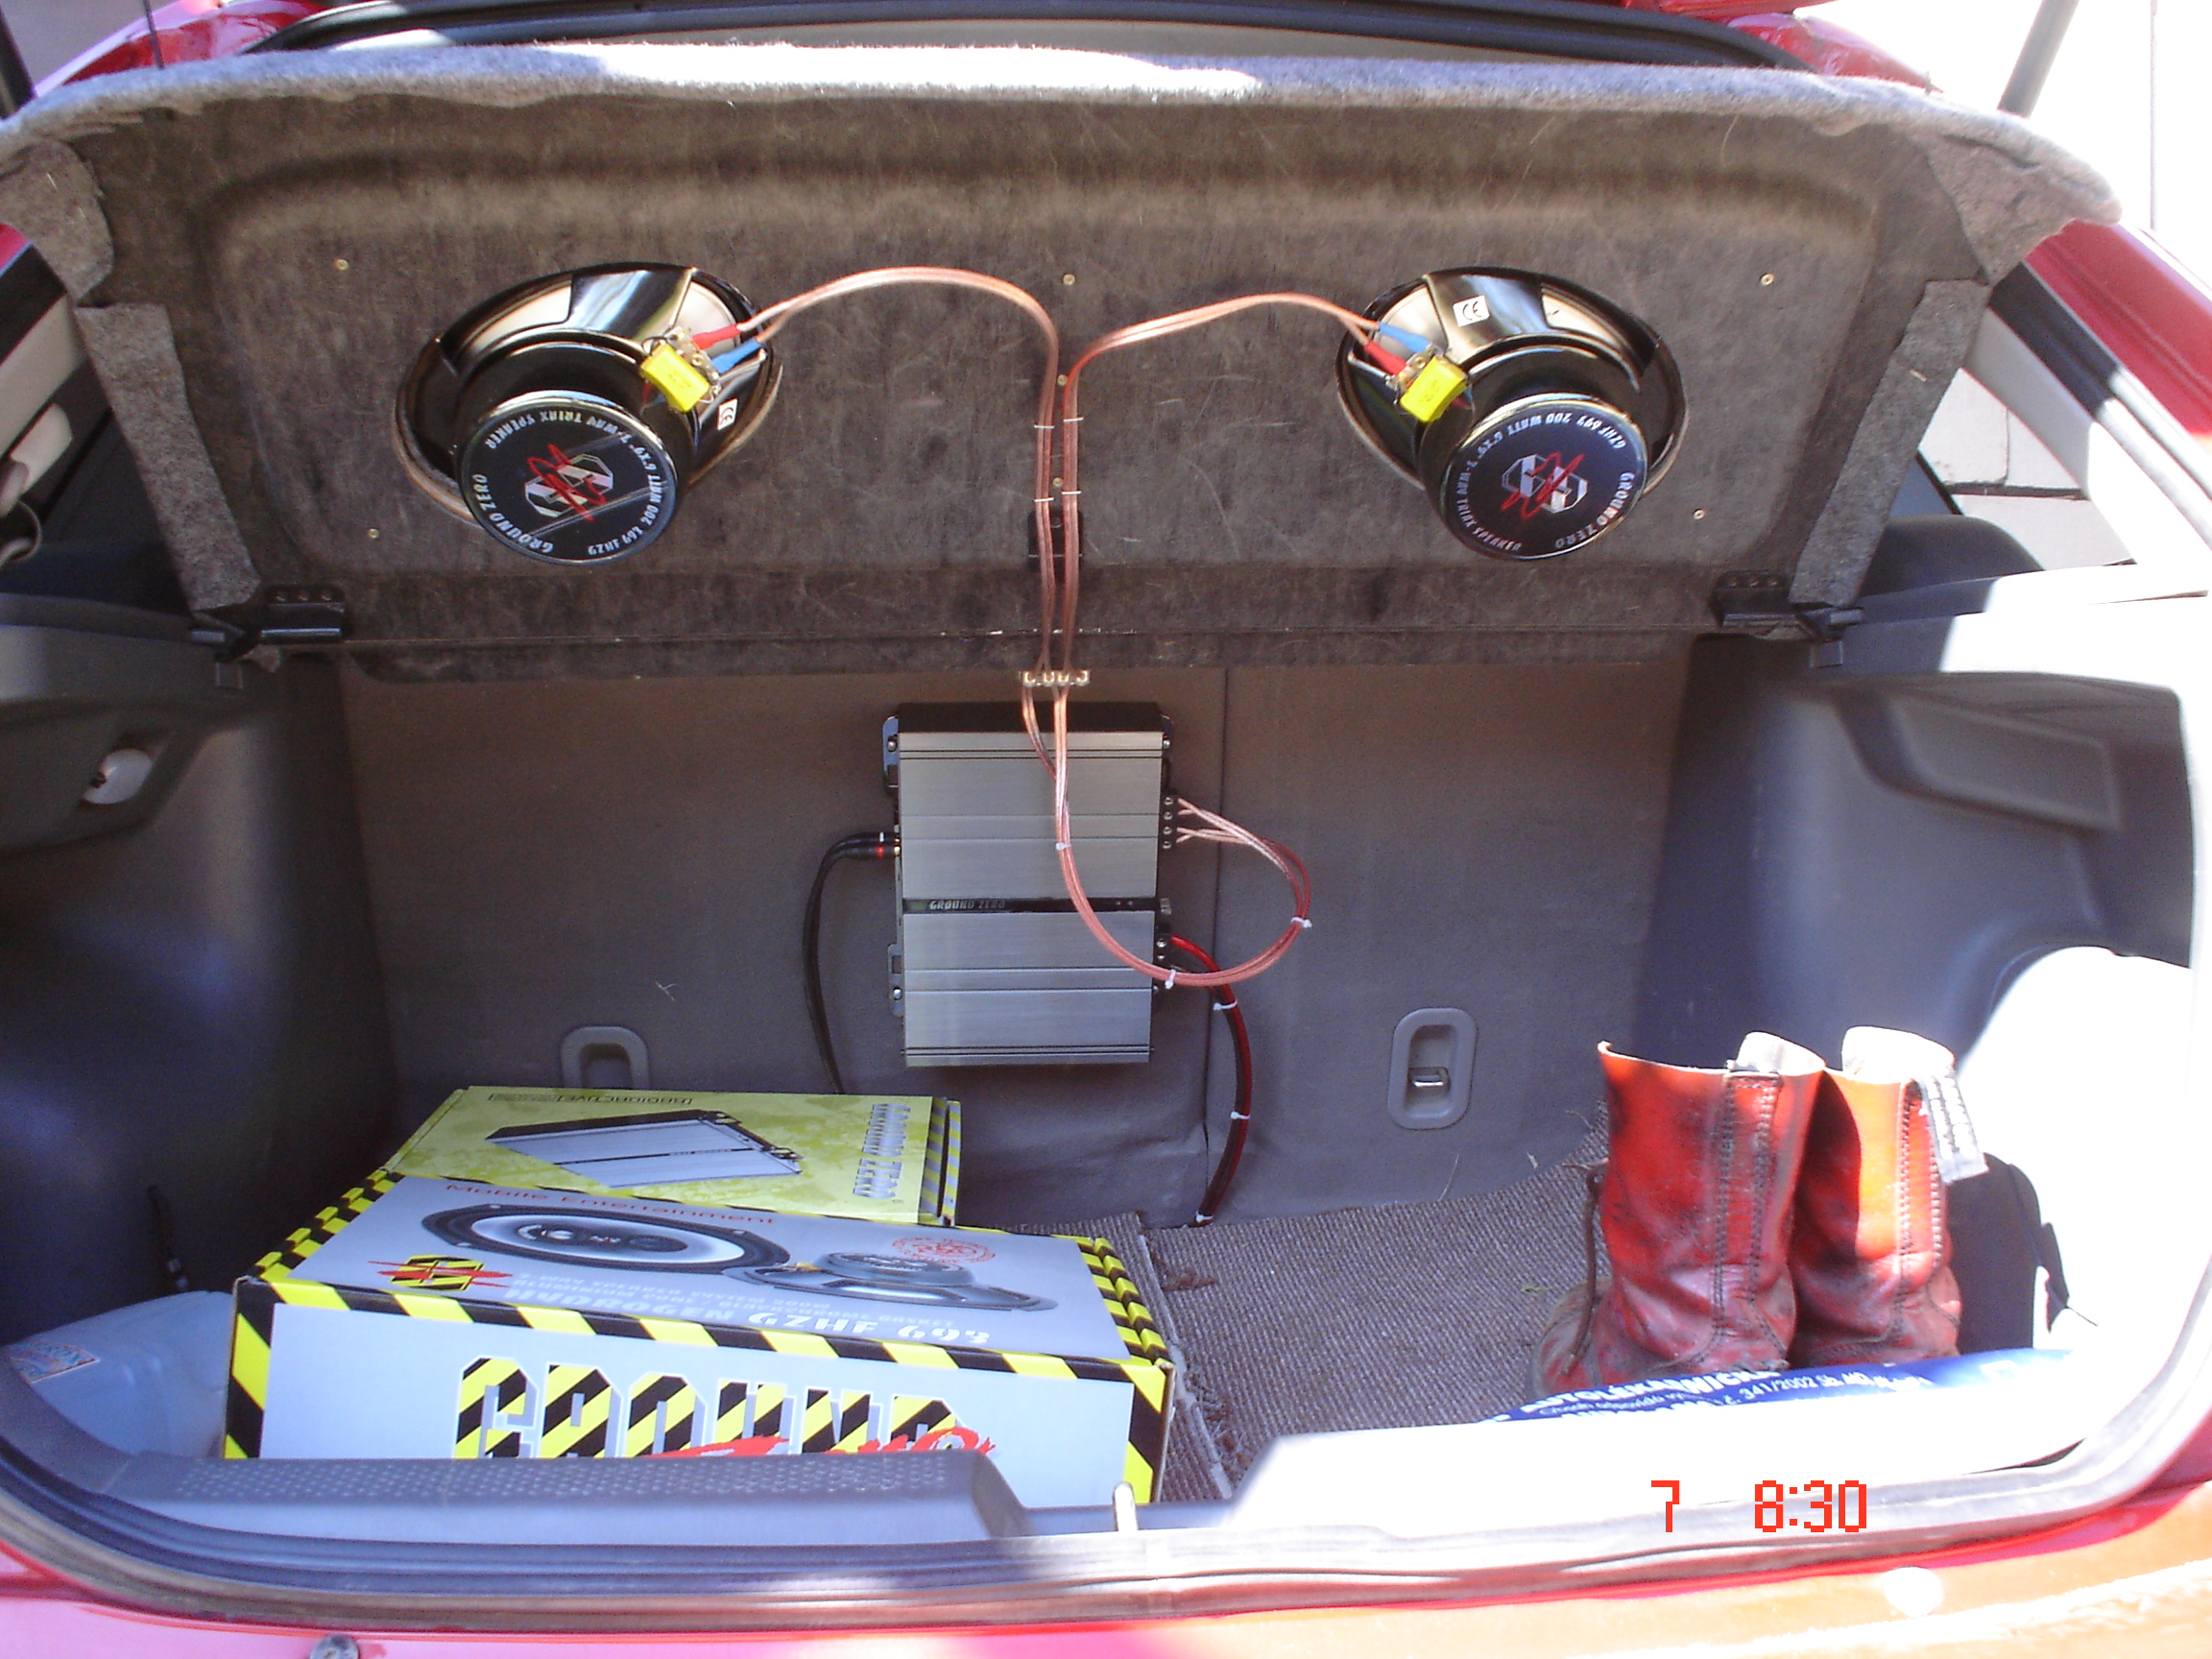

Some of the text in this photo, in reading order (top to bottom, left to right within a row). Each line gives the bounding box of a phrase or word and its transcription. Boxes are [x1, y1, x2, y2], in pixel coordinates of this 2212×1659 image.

[540, 410, 583, 423] TRIAX
[1506, 414, 1543, 436] WATT
[1545, 412, 1572, 425] 200
[484, 413, 536, 449] SPEAKER
[1598, 424, 1628, 449] GZHF
[648, 474, 663, 504] WATT
[471, 473, 554, 554] GROUND ZERO
[640, 505, 660, 527] 200
[1455, 498, 1479, 528] TRIAX
[1554, 471, 1637, 549] GROUND ZERO
[588, 539, 621, 556] GZHF
[1472, 527, 1523, 552] SPEAKER
[929, 899, 1007, 910] GROUND ZERO
[853, 1158, 903, 1199] ZERO
[445, 1184, 775, 1224] Mobile Entertainment
[503, 1288, 991, 1344] HYDROGEN GZHF 693
